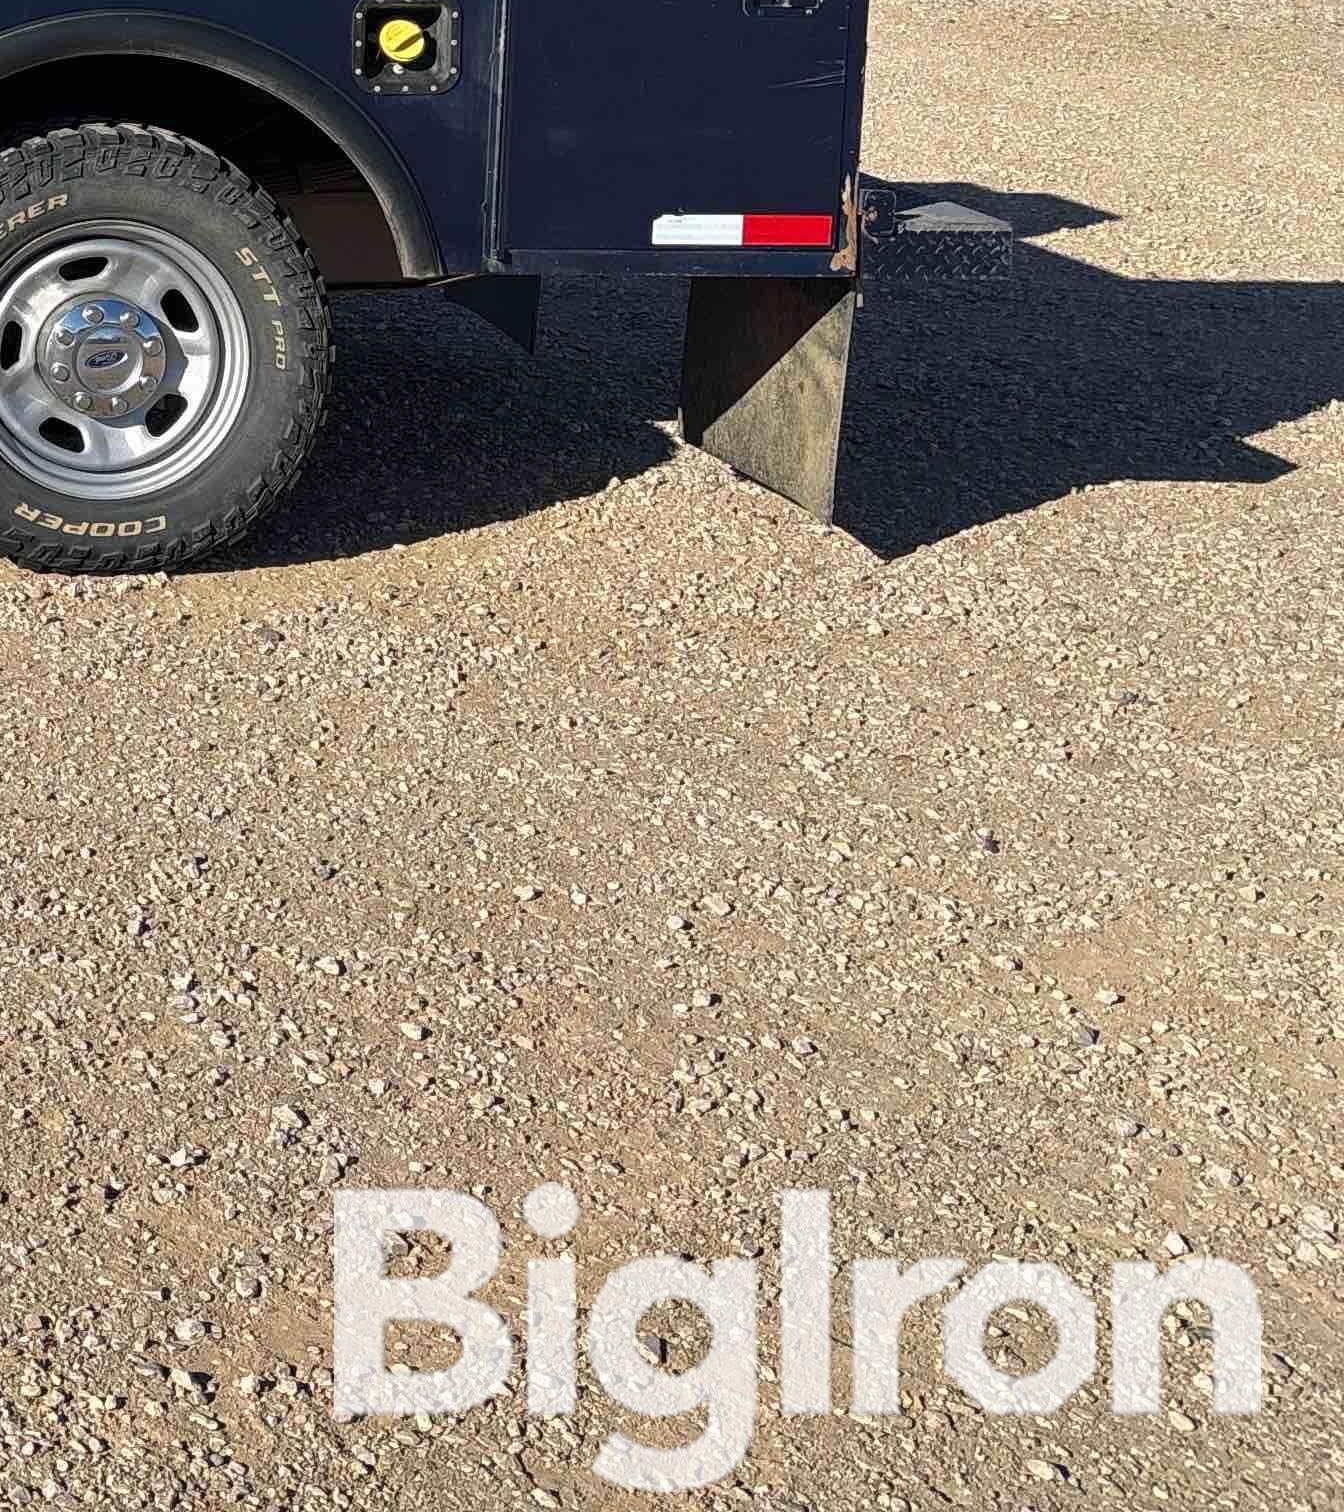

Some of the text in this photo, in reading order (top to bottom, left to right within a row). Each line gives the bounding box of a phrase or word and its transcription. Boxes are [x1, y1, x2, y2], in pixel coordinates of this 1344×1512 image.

[234, 247, 287, 371] STT PRO
[14, 500, 168, 538] COOPER
